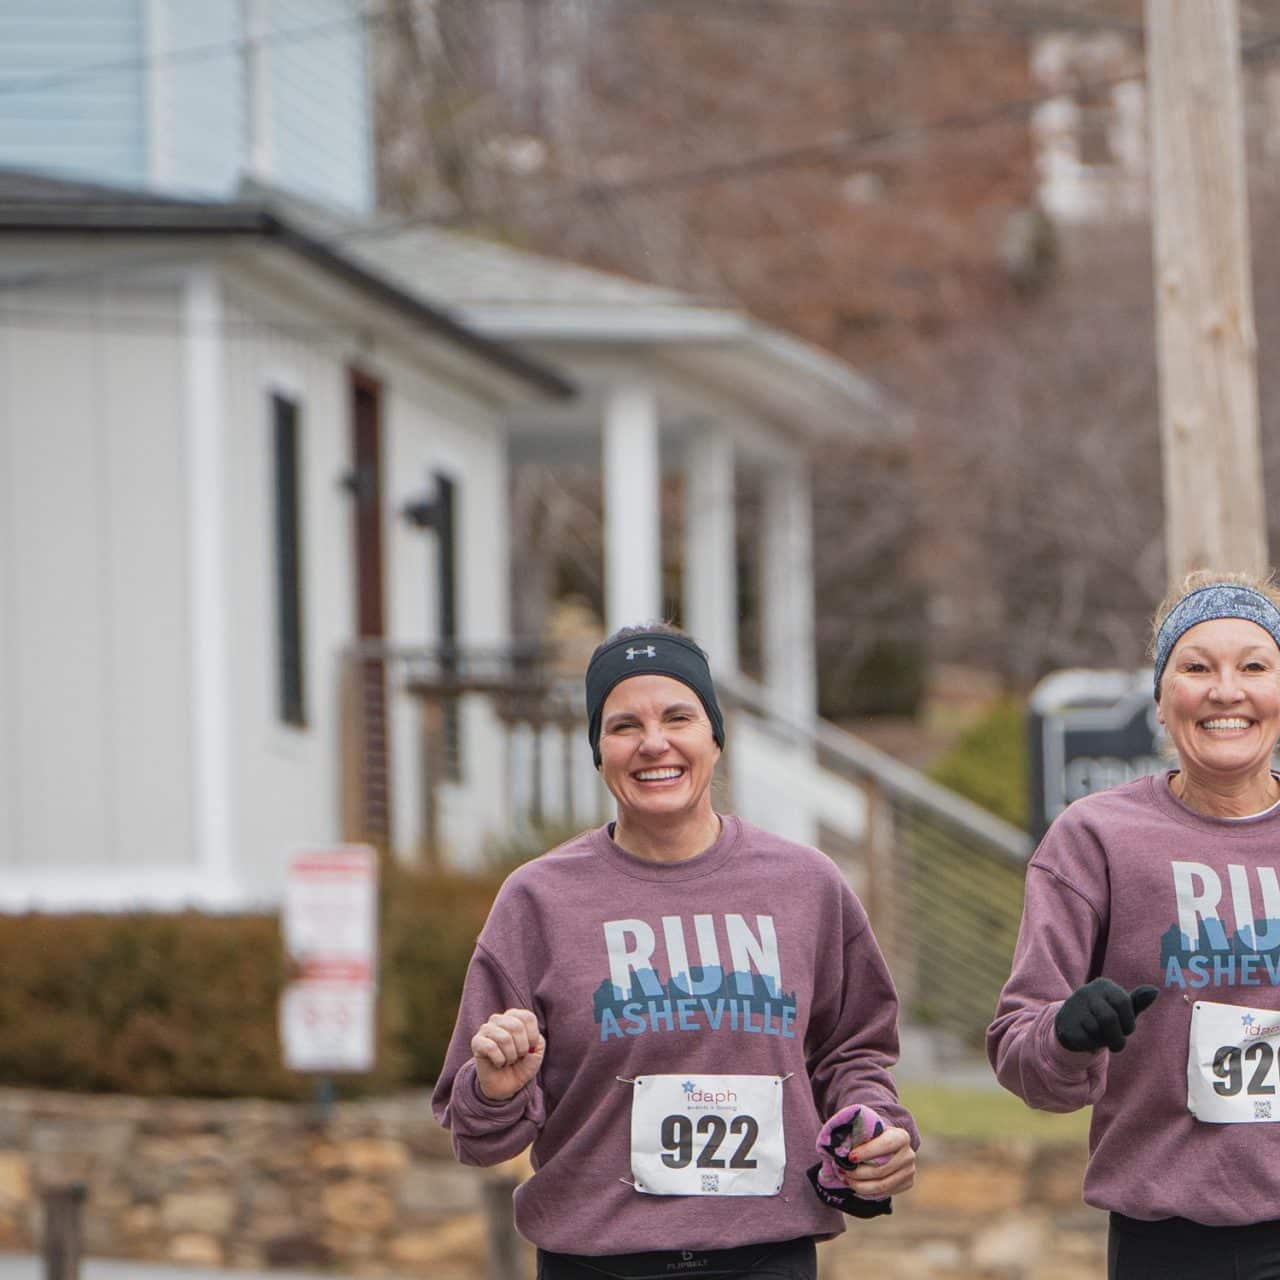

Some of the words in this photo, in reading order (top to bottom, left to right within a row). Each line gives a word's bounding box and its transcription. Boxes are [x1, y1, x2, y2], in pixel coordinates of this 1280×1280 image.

[602, 913, 783, 1001] RUN
[599, 999, 797, 1042] ASHEVILLE
[687, 1089, 737, 1105] idaph
[660, 1114, 760, 1170] 922
